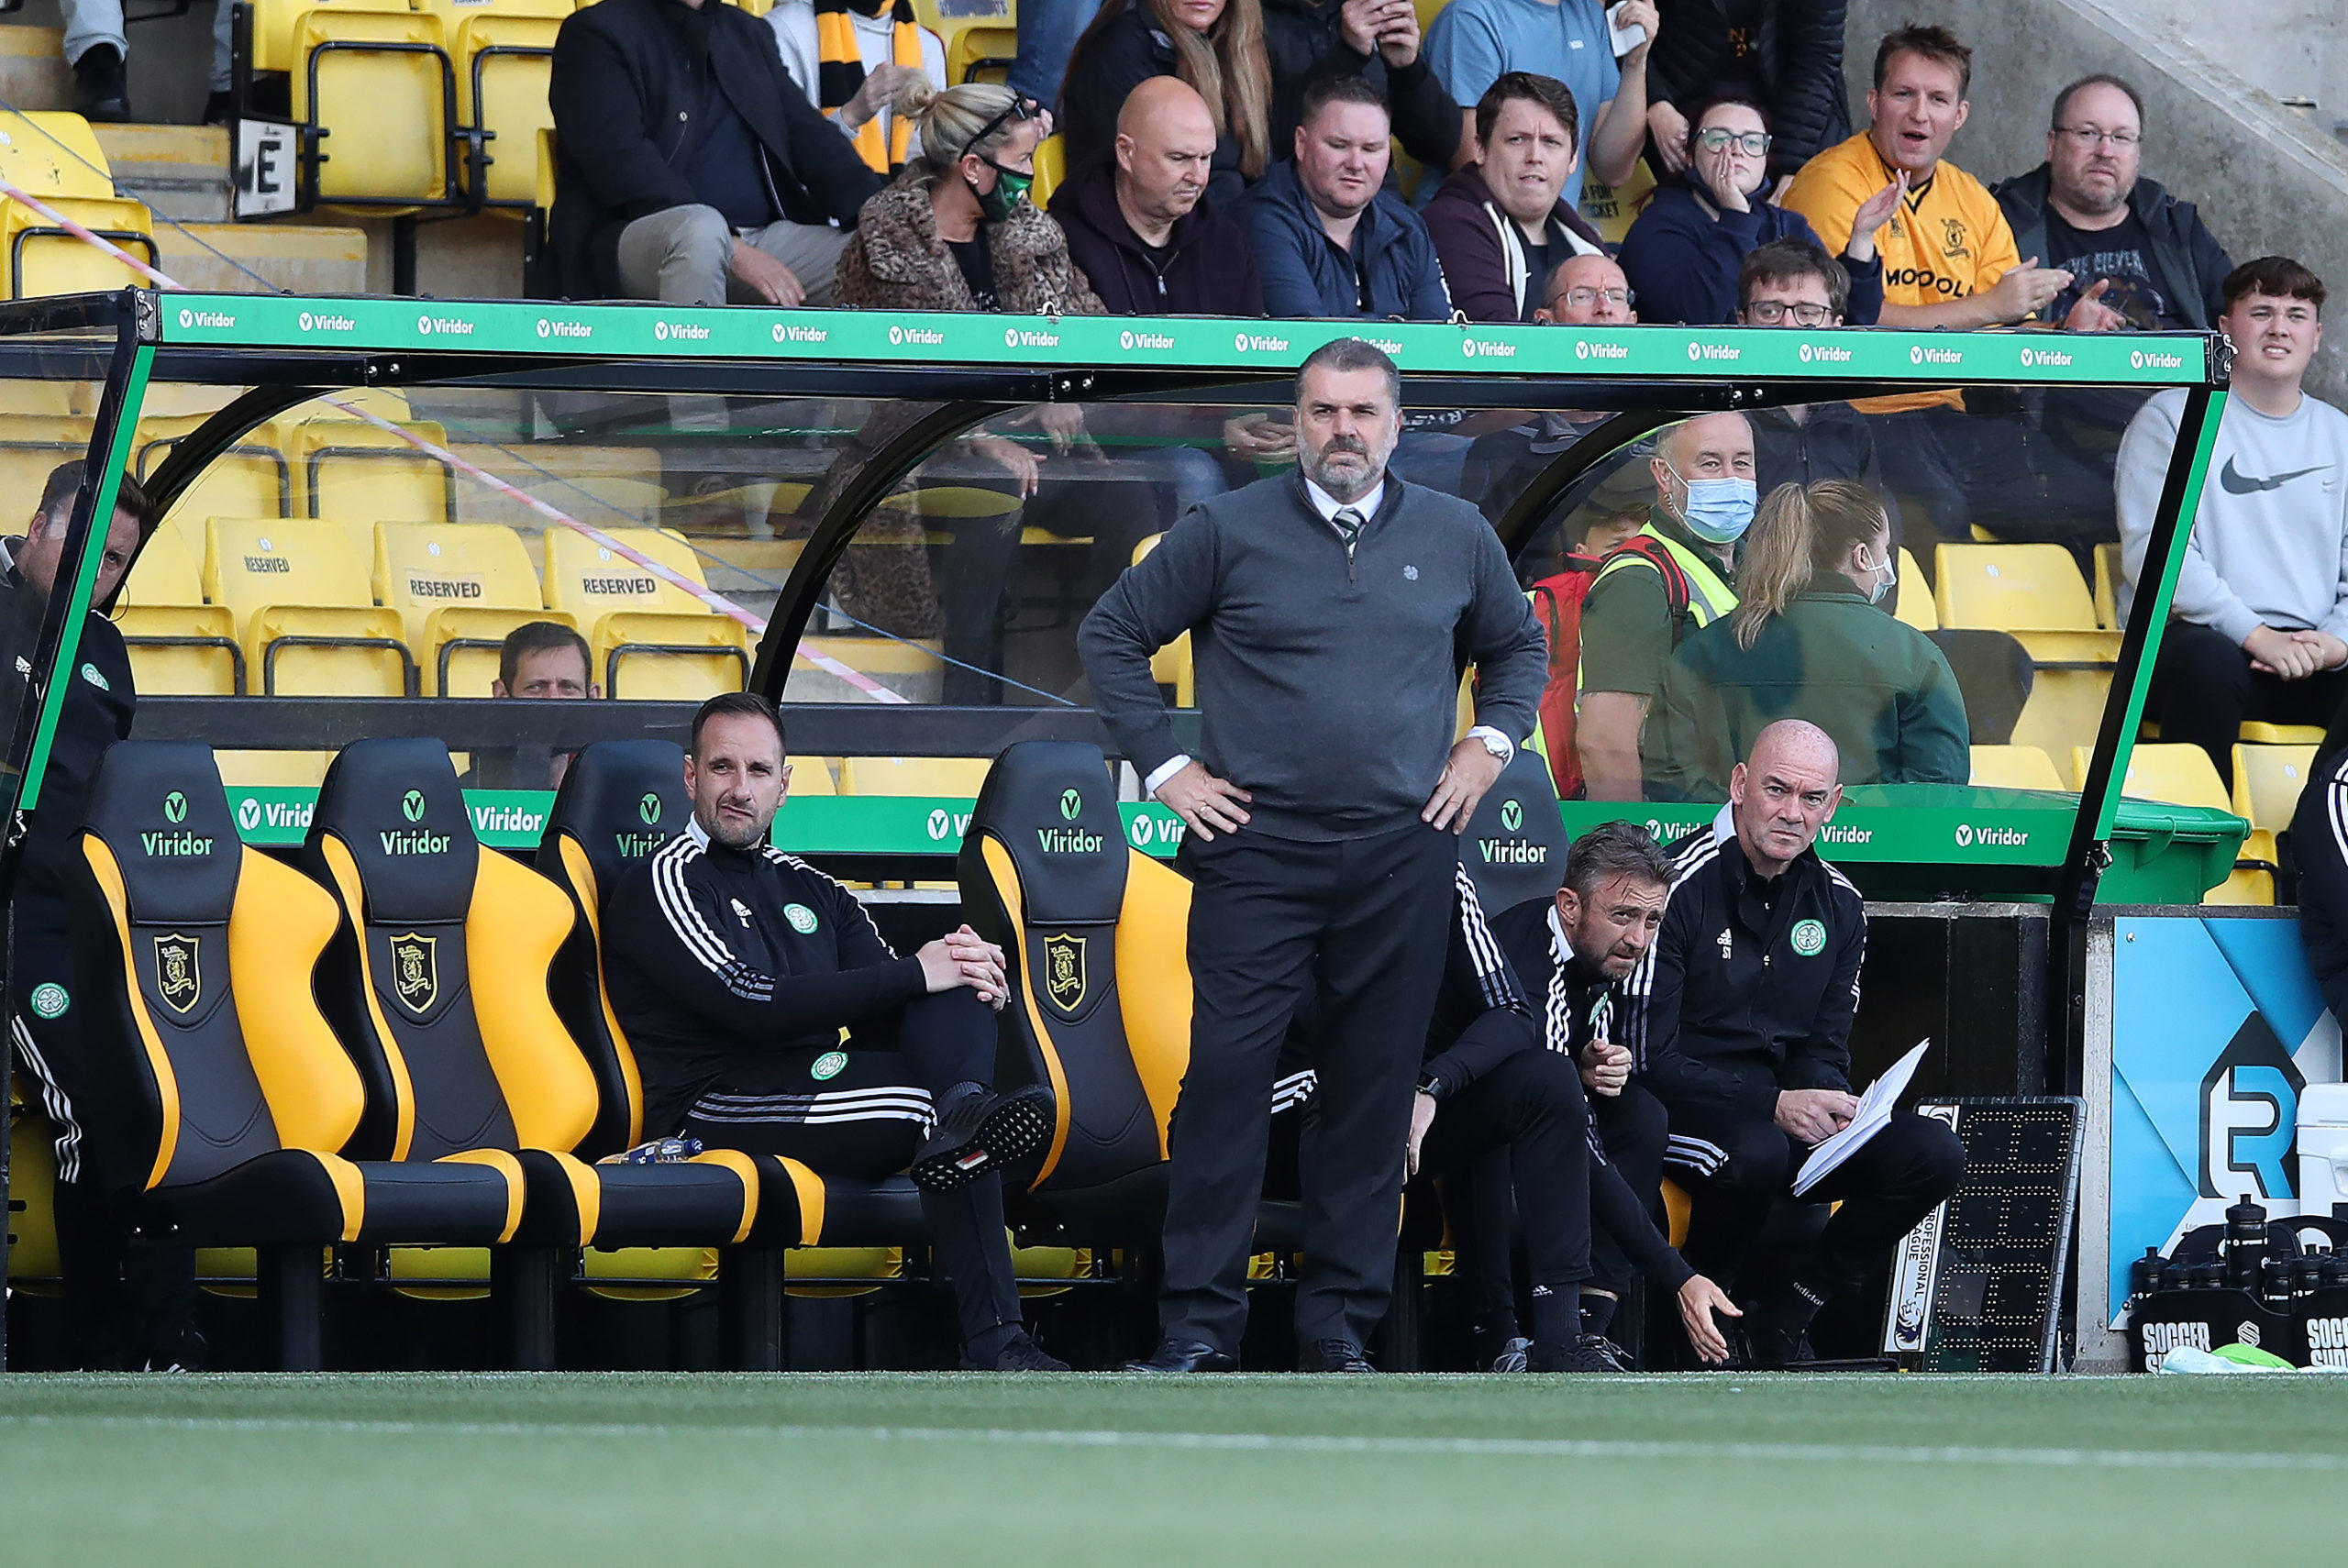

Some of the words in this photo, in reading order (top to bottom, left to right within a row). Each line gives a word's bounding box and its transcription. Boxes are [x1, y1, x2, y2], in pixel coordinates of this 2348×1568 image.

[258, 140, 282, 193] E
[194, 312, 236, 327] Viridor
[314, 315, 355, 331] Viridor
[432, 318, 474, 335] Viridor
[551, 322, 593, 337] Viridor
[669, 324, 711, 339] Viridor
[786, 326, 827, 342] Viridor
[903, 328, 944, 345] Viridor
[1019, 331, 1059, 347] Viridor
[1135, 333, 1175, 349] Viridor
[1249, 336, 1290, 351] Viridor
[1477, 341, 1516, 357] Viridor
[1589, 343, 1629, 359] Viridor
[1701, 344, 1741, 360] Viridor
[1812, 346, 1852, 362] Viridor
[1923, 348, 1963, 363] Viridor
[2033, 350, 2073, 366] Viridor
[2143, 353, 2183, 368] Viridor
[410, 579, 481, 598] RESERVED
[582, 578, 657, 594] RESERVED
[474, 806, 544, 832] Viridor
[380, 829, 451, 856] Viridor
[1037, 828, 1104, 854] Viridor
[1820, 825, 1873, 844] Viridor
[1976, 827, 2030, 845] Viridor
[140, 831, 214, 856] Viridor
[1479, 838, 1548, 864] Viridor
[1909, 1220, 1924, 1262] AGUE
[2142, 1321, 2211, 1353] SOCCER
